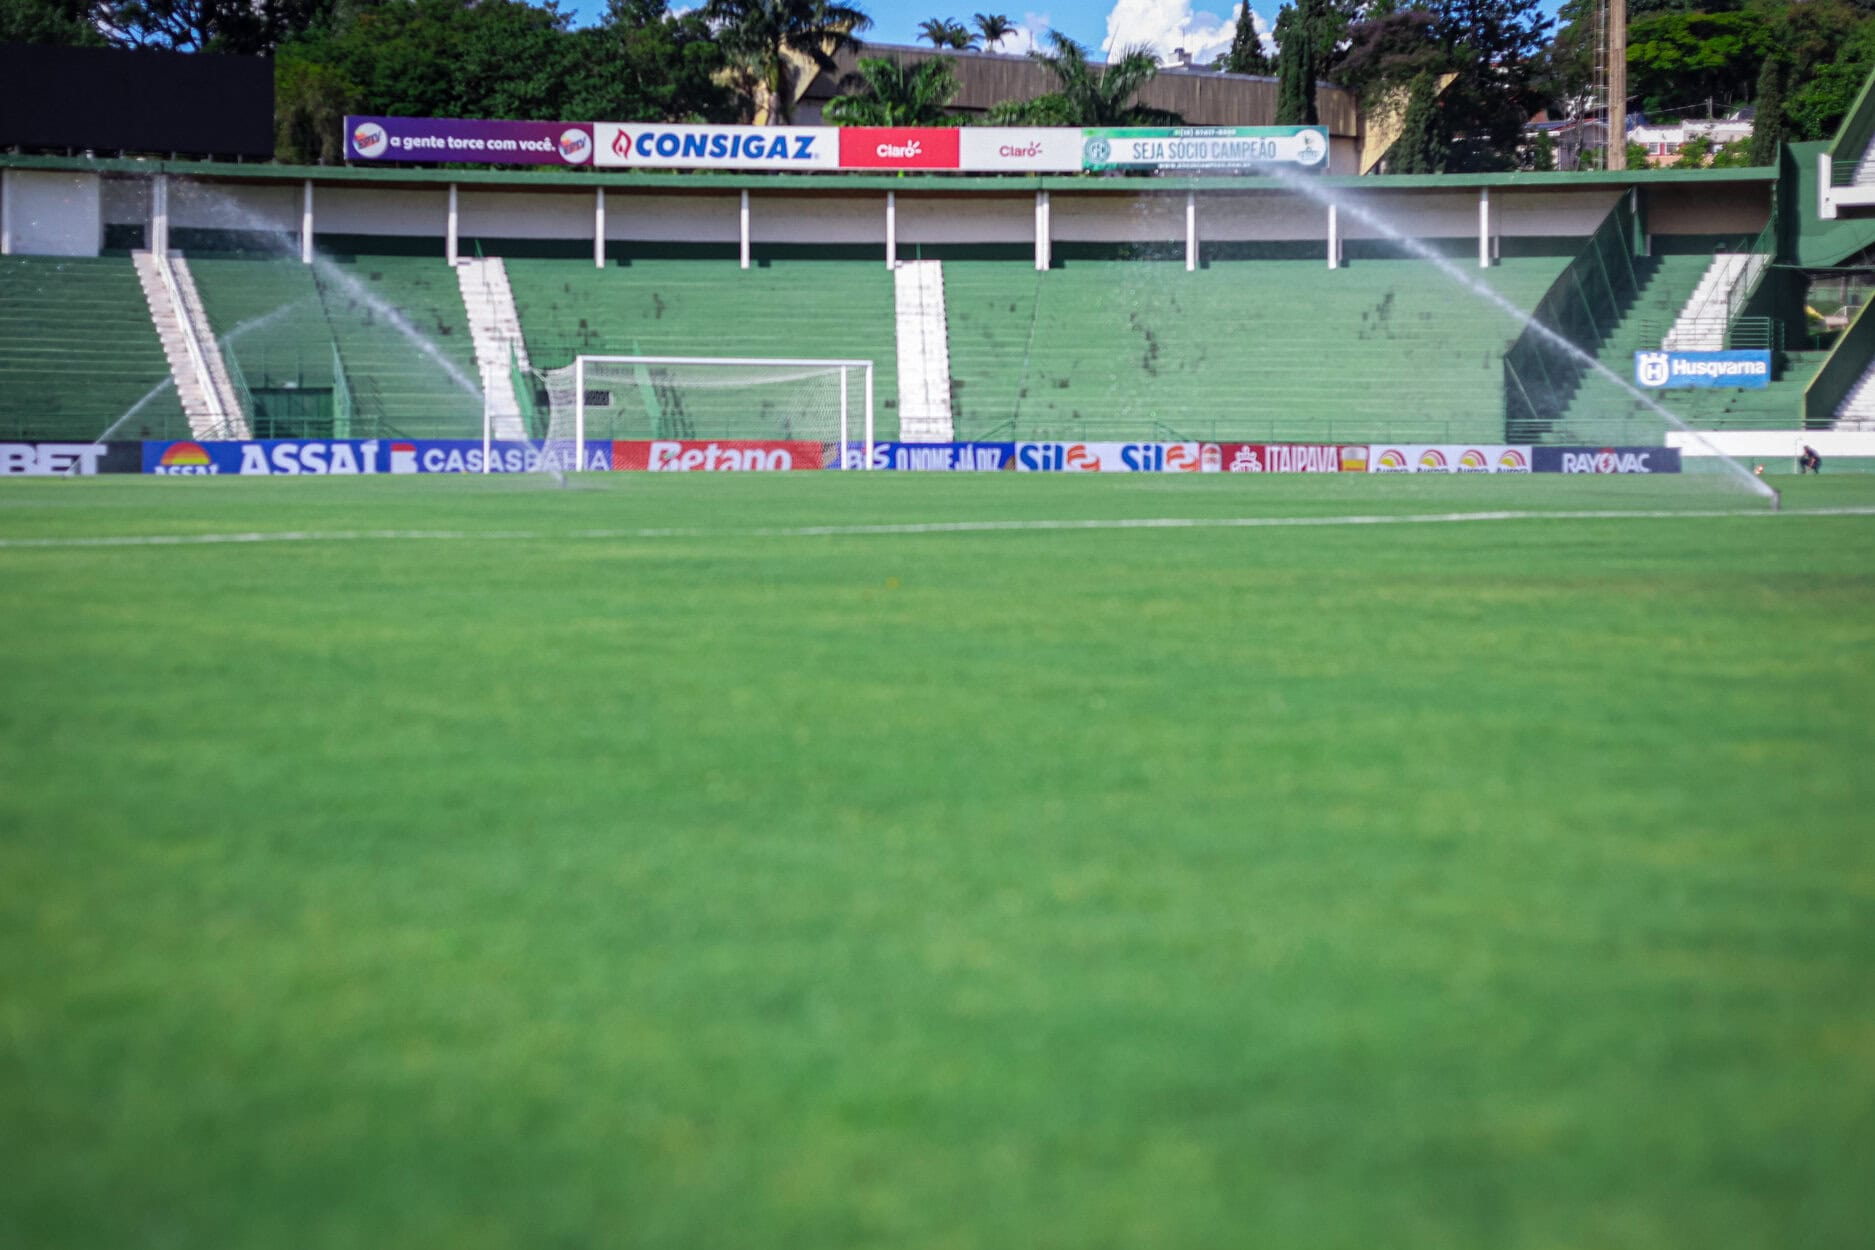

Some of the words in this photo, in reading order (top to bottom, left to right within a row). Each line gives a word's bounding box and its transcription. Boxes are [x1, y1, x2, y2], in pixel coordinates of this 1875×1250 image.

[390, 137, 401, 148] a
[403, 135, 445, 150] gente
[447, 136, 484, 149] torce
[487, 139, 517, 150] com
[519, 137, 556, 151] você.
[635, 132, 816, 159] CONSIGAZ
[876, 141, 919, 158] Claro
[999, 142, 1039, 158] Claro
[1133, 142, 1164, 160] SEJA
[1168, 137, 1207, 160] SÓCIO
[1212, 137, 1277, 159] CAMPEÃO
[1672, 359, 1766, 377] Husqvarna
[647, 441, 792, 471] Betano
[1019, 444, 1063, 471] Sil
[1121, 444, 1163, 471] Sil
[1267, 445, 1339, 472] ITAIPAVA
[1562, 451, 1650, 473] RAYOVAC
